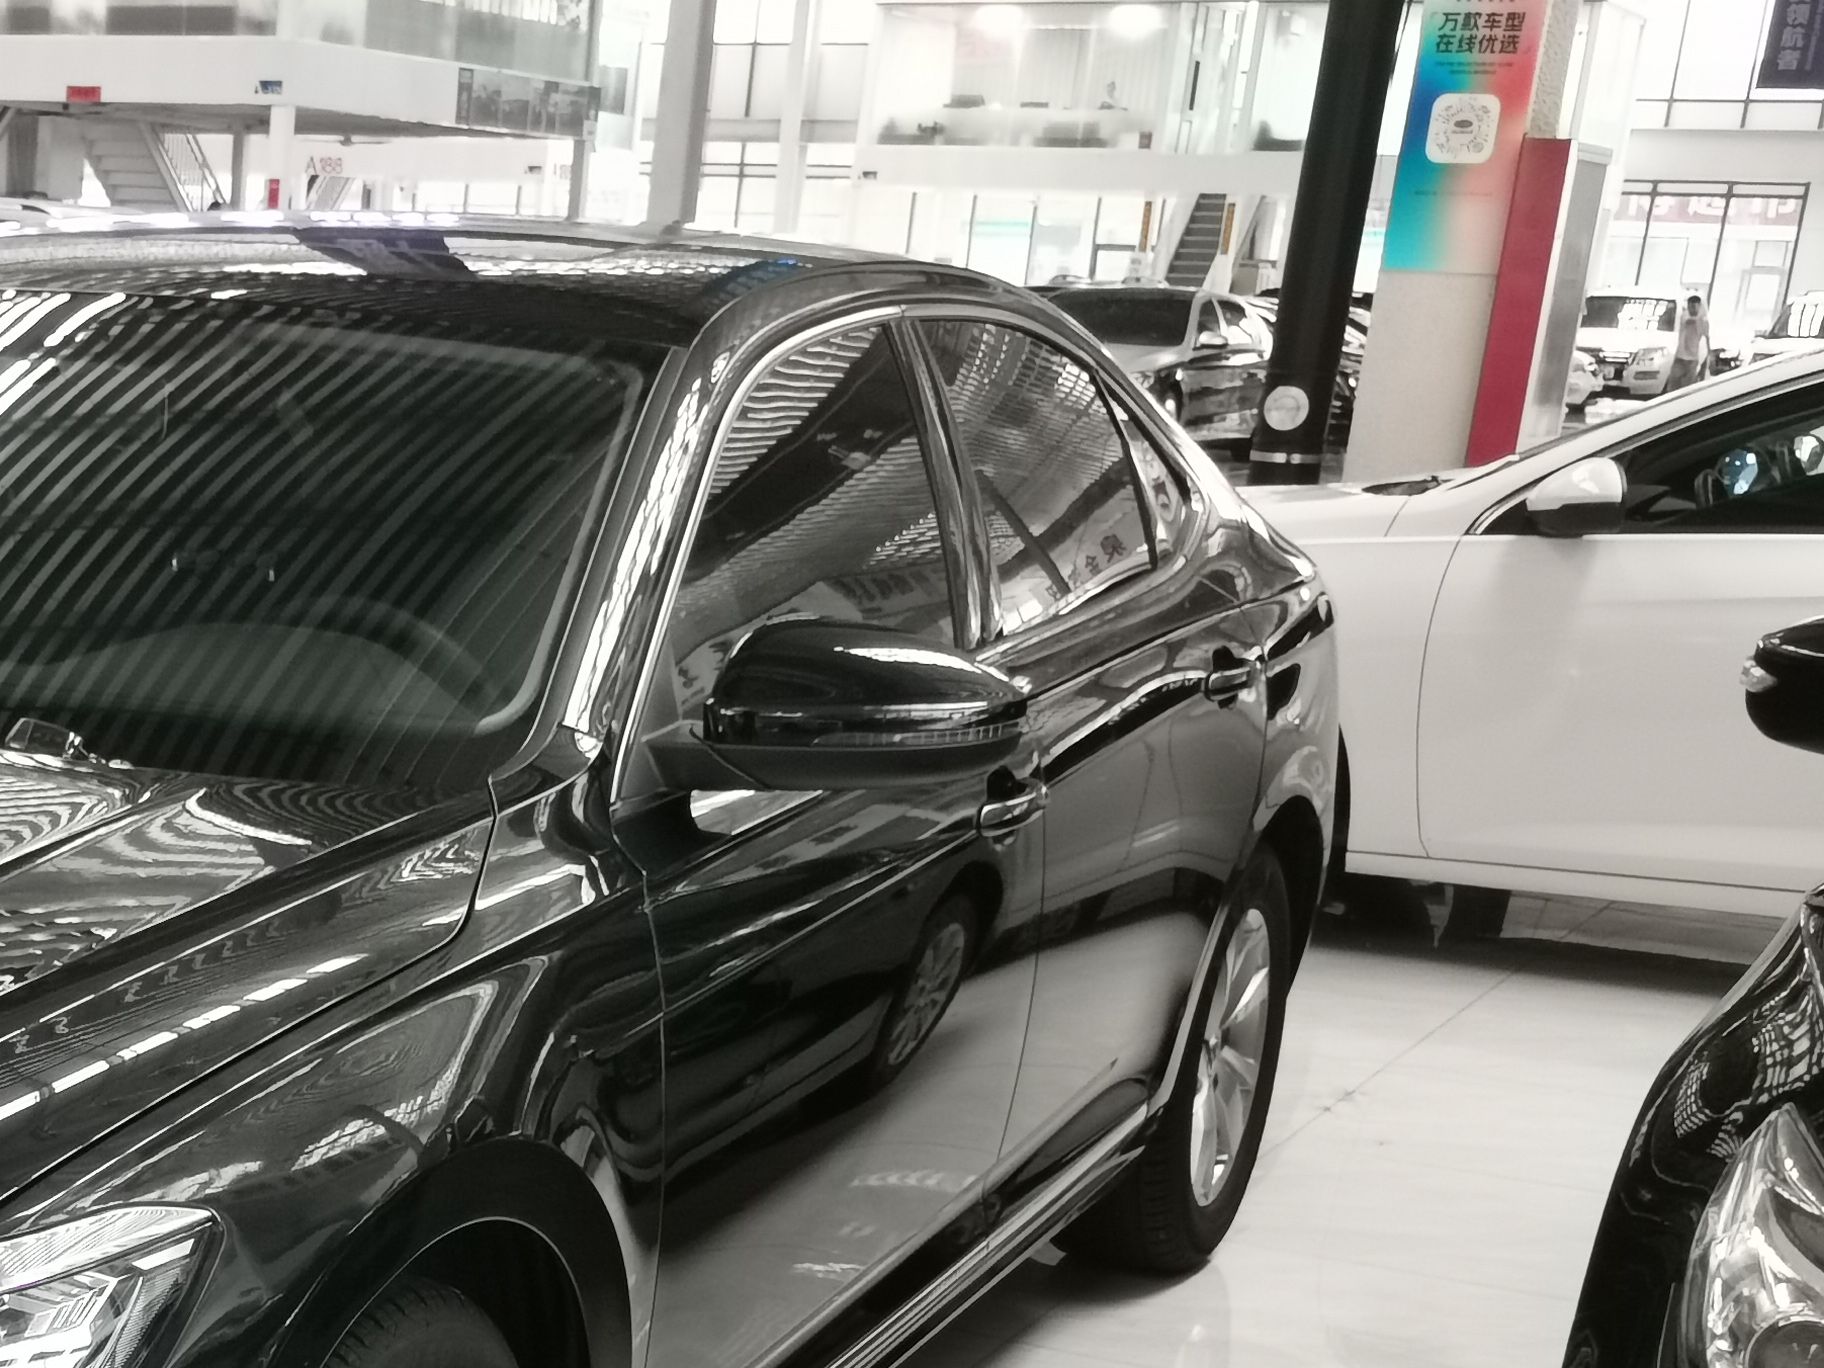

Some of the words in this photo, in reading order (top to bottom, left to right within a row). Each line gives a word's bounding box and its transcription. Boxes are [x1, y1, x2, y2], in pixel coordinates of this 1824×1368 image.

[1438, 12, 1526, 32] 万款车型
[1435, 33, 1520, 54] 在线优选
[1777, 0, 1811, 70] 领航者
